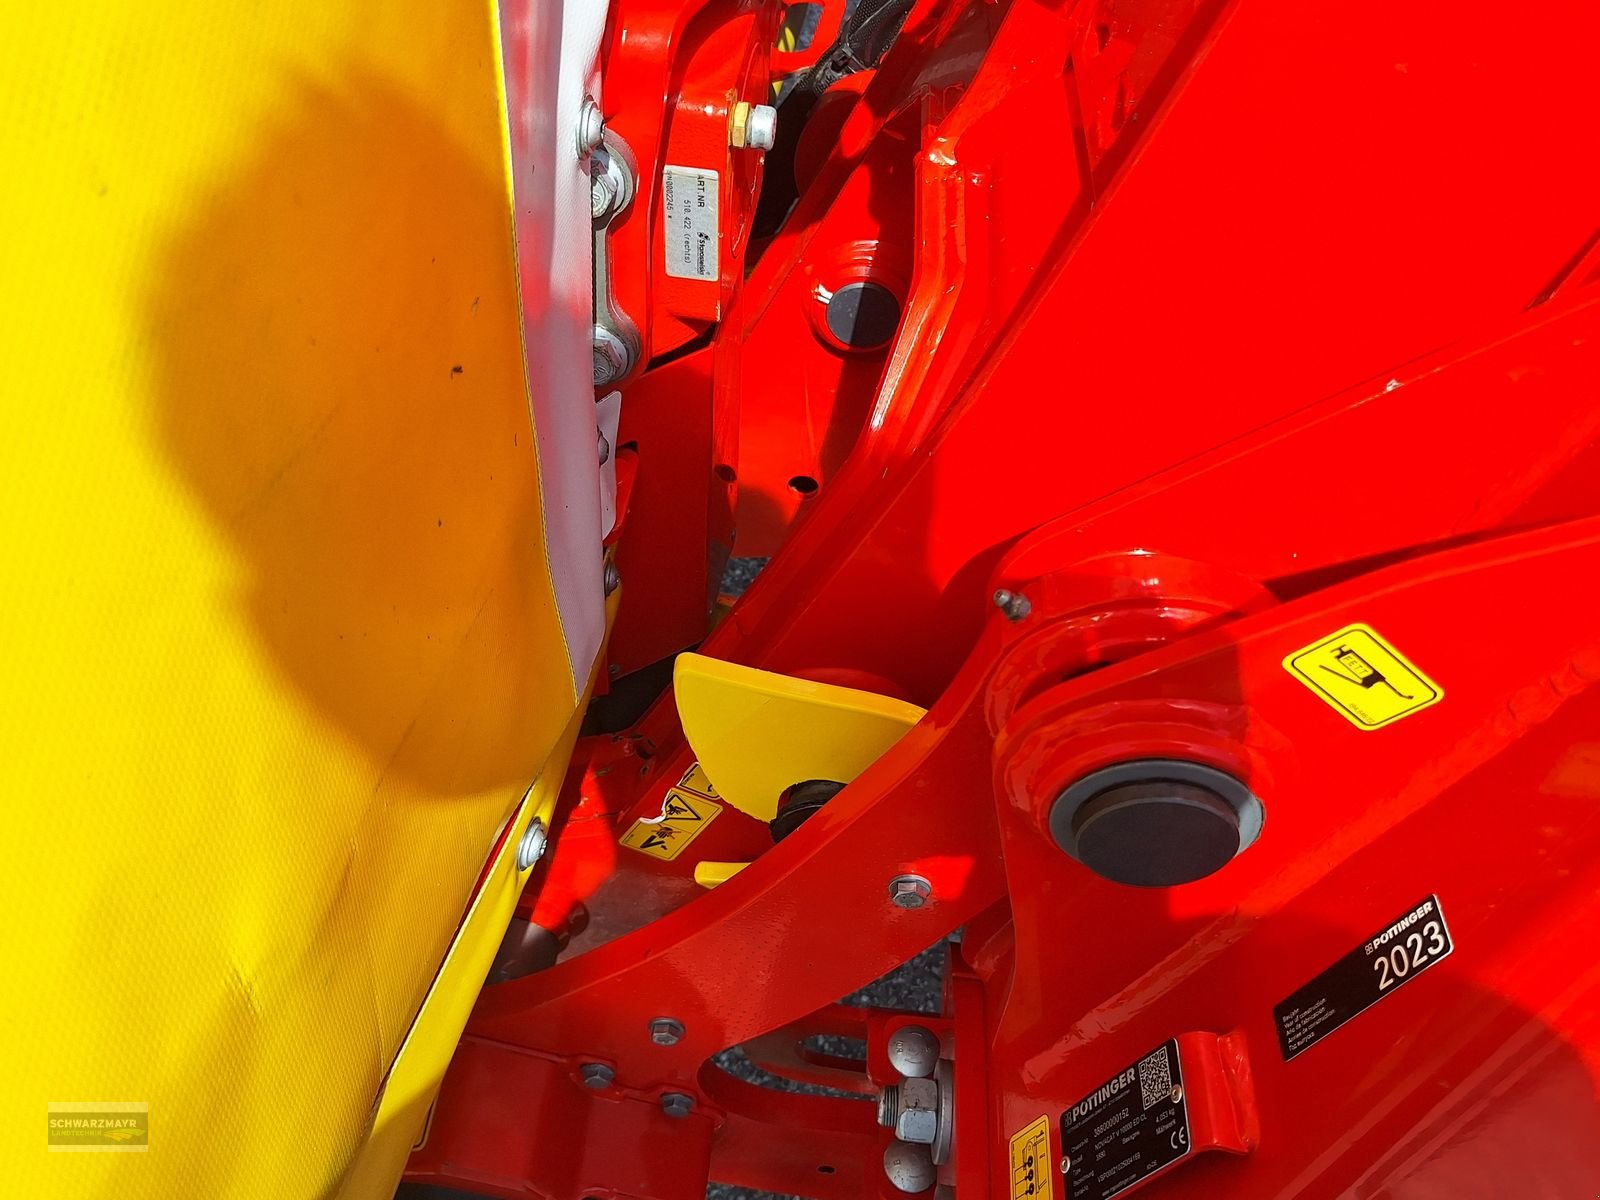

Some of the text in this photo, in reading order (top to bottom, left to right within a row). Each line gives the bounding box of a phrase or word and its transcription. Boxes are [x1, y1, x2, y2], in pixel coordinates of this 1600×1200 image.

[683, 233, 692, 264] (rechts)
[1344, 655, 1369, 675] FETT
[1374, 921, 1445, 991] 2023
